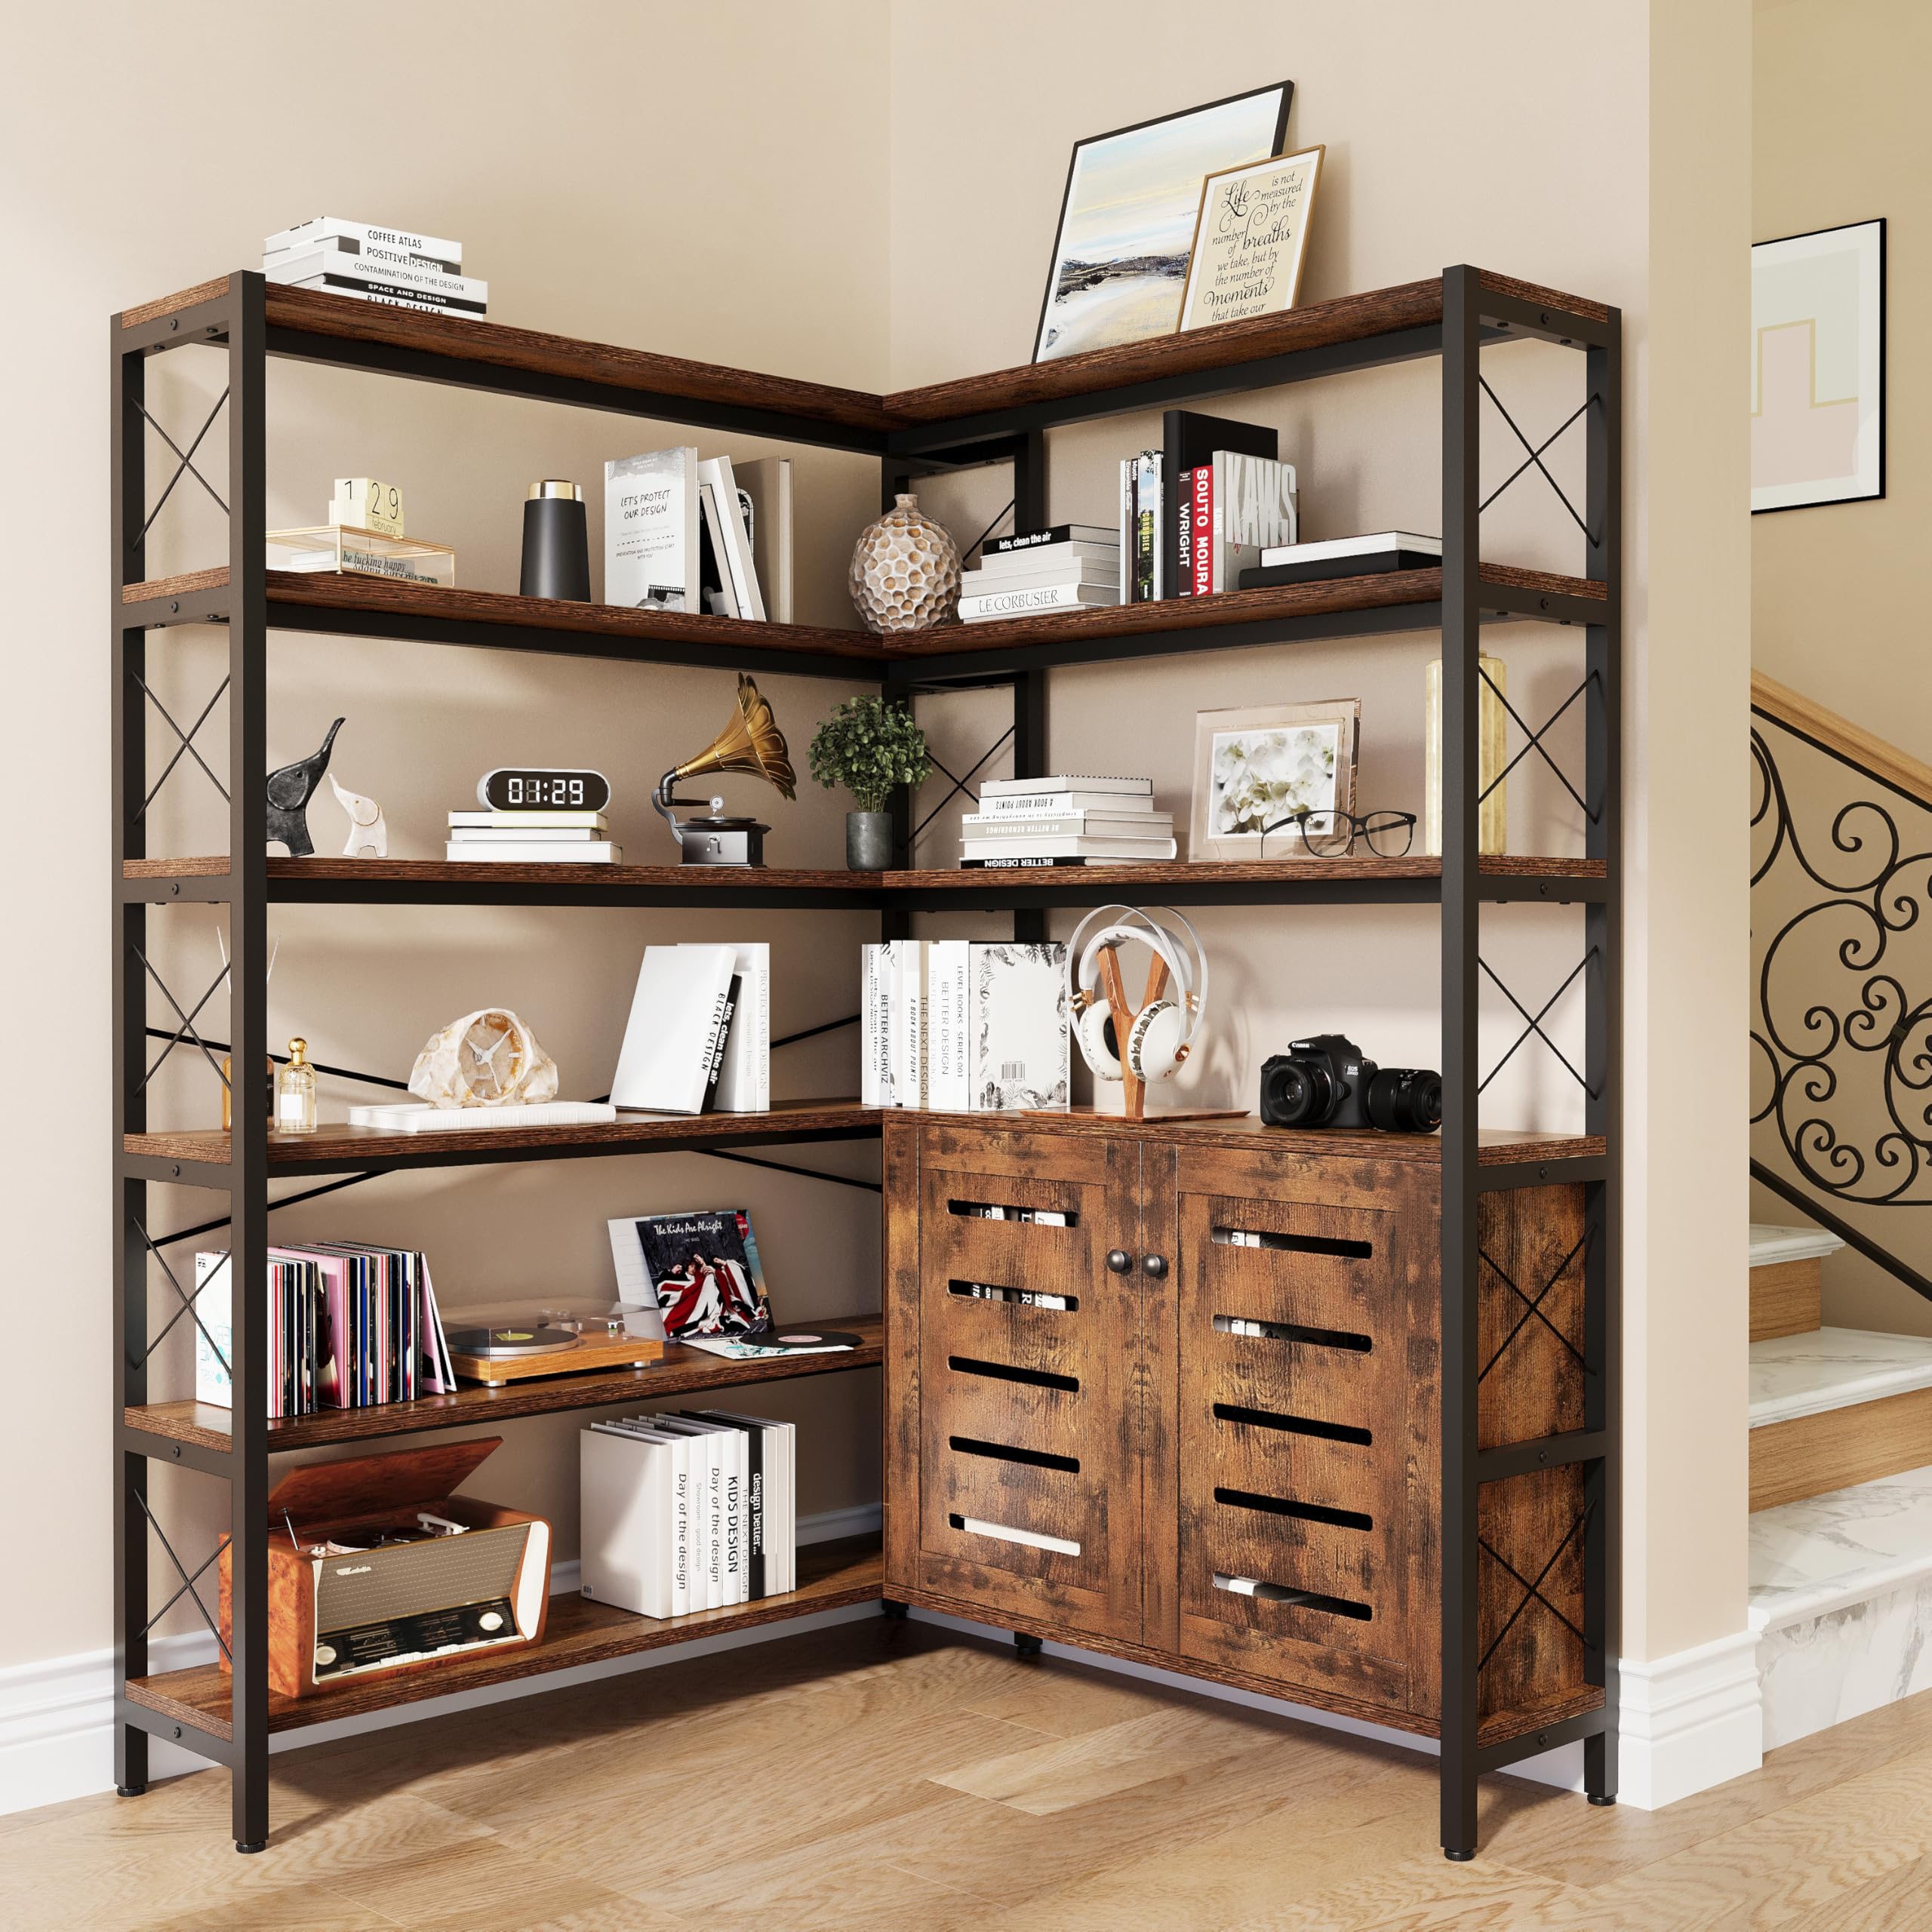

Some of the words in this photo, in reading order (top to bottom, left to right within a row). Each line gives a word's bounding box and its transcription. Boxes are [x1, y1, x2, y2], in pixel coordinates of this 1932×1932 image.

[1261, 179, 1303, 201] measured
[1272, 176, 1279, 186] is
[1280, 171, 1296, 184] not
[1269, 202, 1281, 216] by
[1282, 198, 1297, 210] the
[368, 229, 396, 244] COFFEE
[398, 235, 423, 249] ATLAS
[1212, 229, 1245, 246] number
[1227, 240, 1240, 259] of
[1243, 205, 1292, 251] breaths
[367, 247, 408, 265] POSITIVE
[410, 257, 443, 272] DESIGN
[1217, 260, 1229, 272] we
[1229, 254, 1250, 270] take,
[1252, 251, 1267, 264] but
[1269, 248, 1280, 264] by
[354, 263, 413, 281] CONTAMINATION
[414, 275, 423, 283] OF
[425, 276, 438, 286] THE
[438, 280, 464, 291] DESIGN
[1215, 275, 1229, 287] the
[1229, 266, 1264, 283] number
[1265, 261, 1275, 279] of
[368, 283, 395, 294] SPACE
[396, 289, 414, 297] AND
[417, 294, 447, 303] DESIGN
[1211, 308, 1230, 322] that
[1231, 304, 1249, 318] take
[1250, 302, 1266, 313] our
[344, 480, 352, 500] 1
[640, 489, 671, 504] PROTECT
[1196, 469, 1209, 528] SOUTO
[1225, 453, 1297, 548] KAWS
[624, 509, 639, 519] OUR
[641, 502, 667, 516] DESIGN
[1214, 507, 1223, 535] KAWS
[373, 516, 397, 535] february
[1180, 503, 1190, 568] WRIGHT
[998, 540, 1013, 551] lets,
[1013, 535, 1030, 547] clean
[1030, 533, 1041, 544] the
[1041, 531, 1052, 541] air
[343, 550, 352, 562] be
[354, 552, 382, 568] fucking
[383, 557, 406, 572] happy
[1196, 537, 1209, 595] MOURA
[979, 598, 992, 613] LE
[994, 589, 1060, 611] CORBUSIER
[508, 778, 583, 804] 01:29
[1050, 798, 1054, 807] A
[995, 800, 1014, 810] POINTS
[1016, 799, 1032, 808] ABOUT
[1034, 798, 1048, 808] BOOK
[984, 859, 1019, 868] DESIGN
[1021, 858, 1054, 867] BETTER
[712, 992, 726, 1026] BLACK
[722, 1001, 734, 1023] lets,
[920, 995, 928, 1018] THE
[941, 982, 949, 1025] BETTER
[717, 1024, 728, 1050] clean
[920, 1022, 928, 1052] NEXT
[701, 1032, 716, 1071] DESIGN
[712, 1051, 723, 1069] the
[941, 1029, 949, 1075] DESIGN
[709, 1070, 718, 1084] air
[920, 1057, 928, 1100] DESIGN
[654, 1224, 666, 1235] The
[666, 1223, 685, 1235] Kids
[685, 1221, 697, 1233] Are
[697, 1220, 723, 1234] Alright
[676, 1474, 687, 1498] Day
[709, 1468, 719, 1494] Day
[749, 1472, 762, 1511] design
[712, 1497, 718, 1511] of
[728, 1475, 738, 1512] KIDS
[679, 1503, 685, 1515] of
[712, 1513, 720, 1536] the
[752, 1512, 762, 1555] better...
[728, 1515, 738, 1573] DESIGN
[676, 1544, 686, 1590] design
[709, 1539, 719, 1583] design
